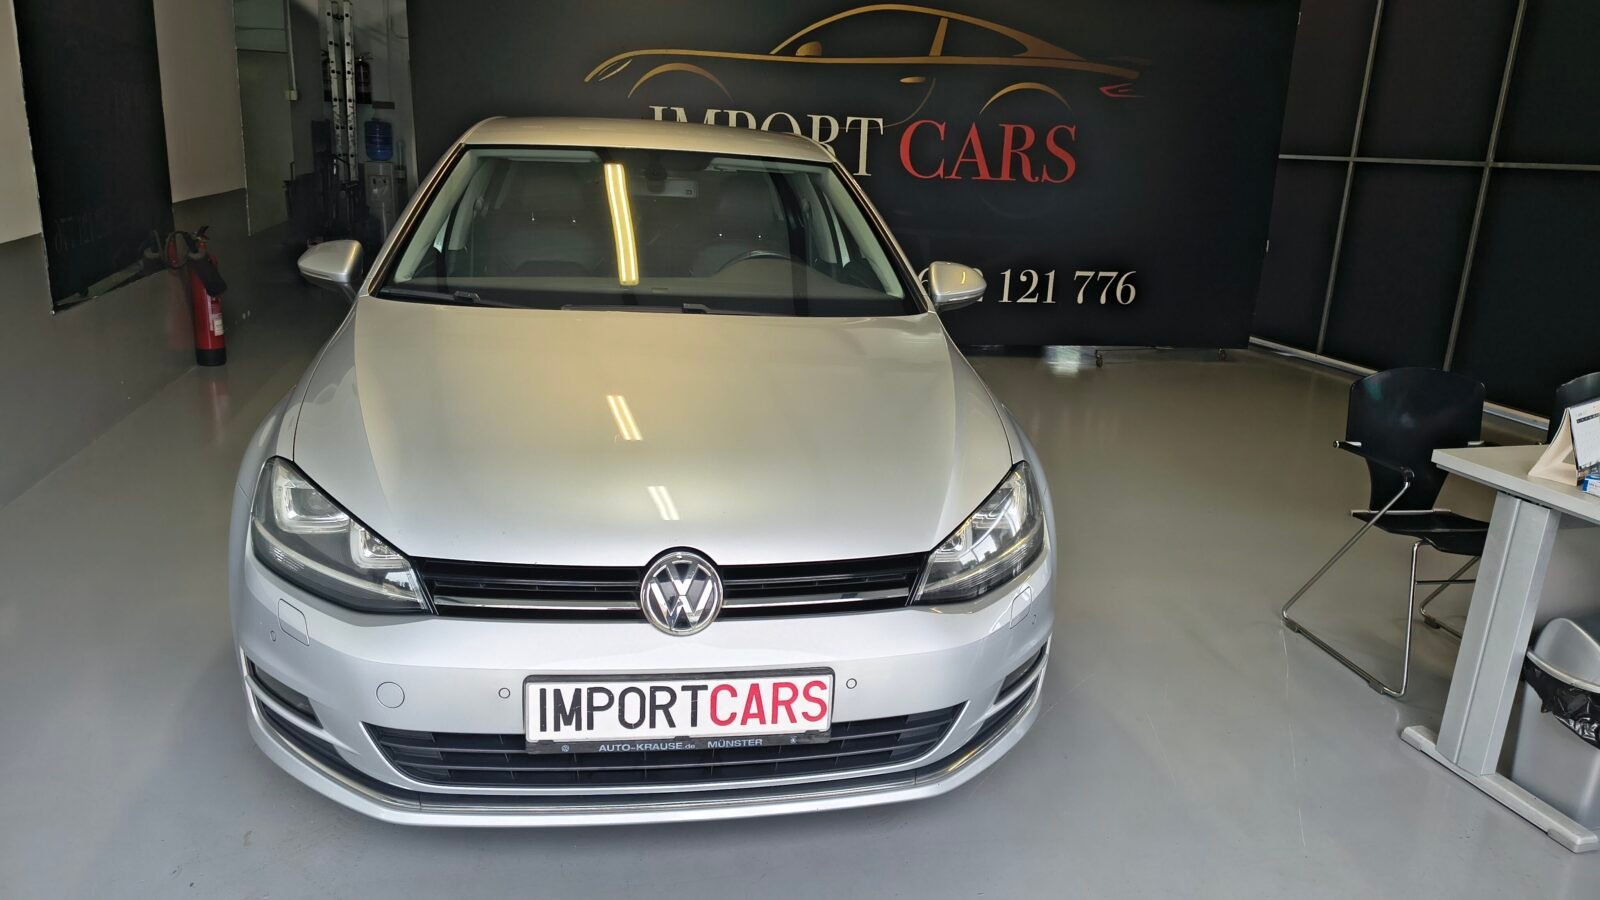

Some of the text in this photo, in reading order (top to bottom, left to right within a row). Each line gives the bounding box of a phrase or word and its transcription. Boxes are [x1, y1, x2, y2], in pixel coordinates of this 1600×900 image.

[899, 119, 1077, 184] CARS
[998, 268, 1056, 304] 121
[1073, 269, 1137, 305] 776
[538, 679, 828, 733] IMPORTCARS
[707, 737, 763, 749] MÜNSTER
